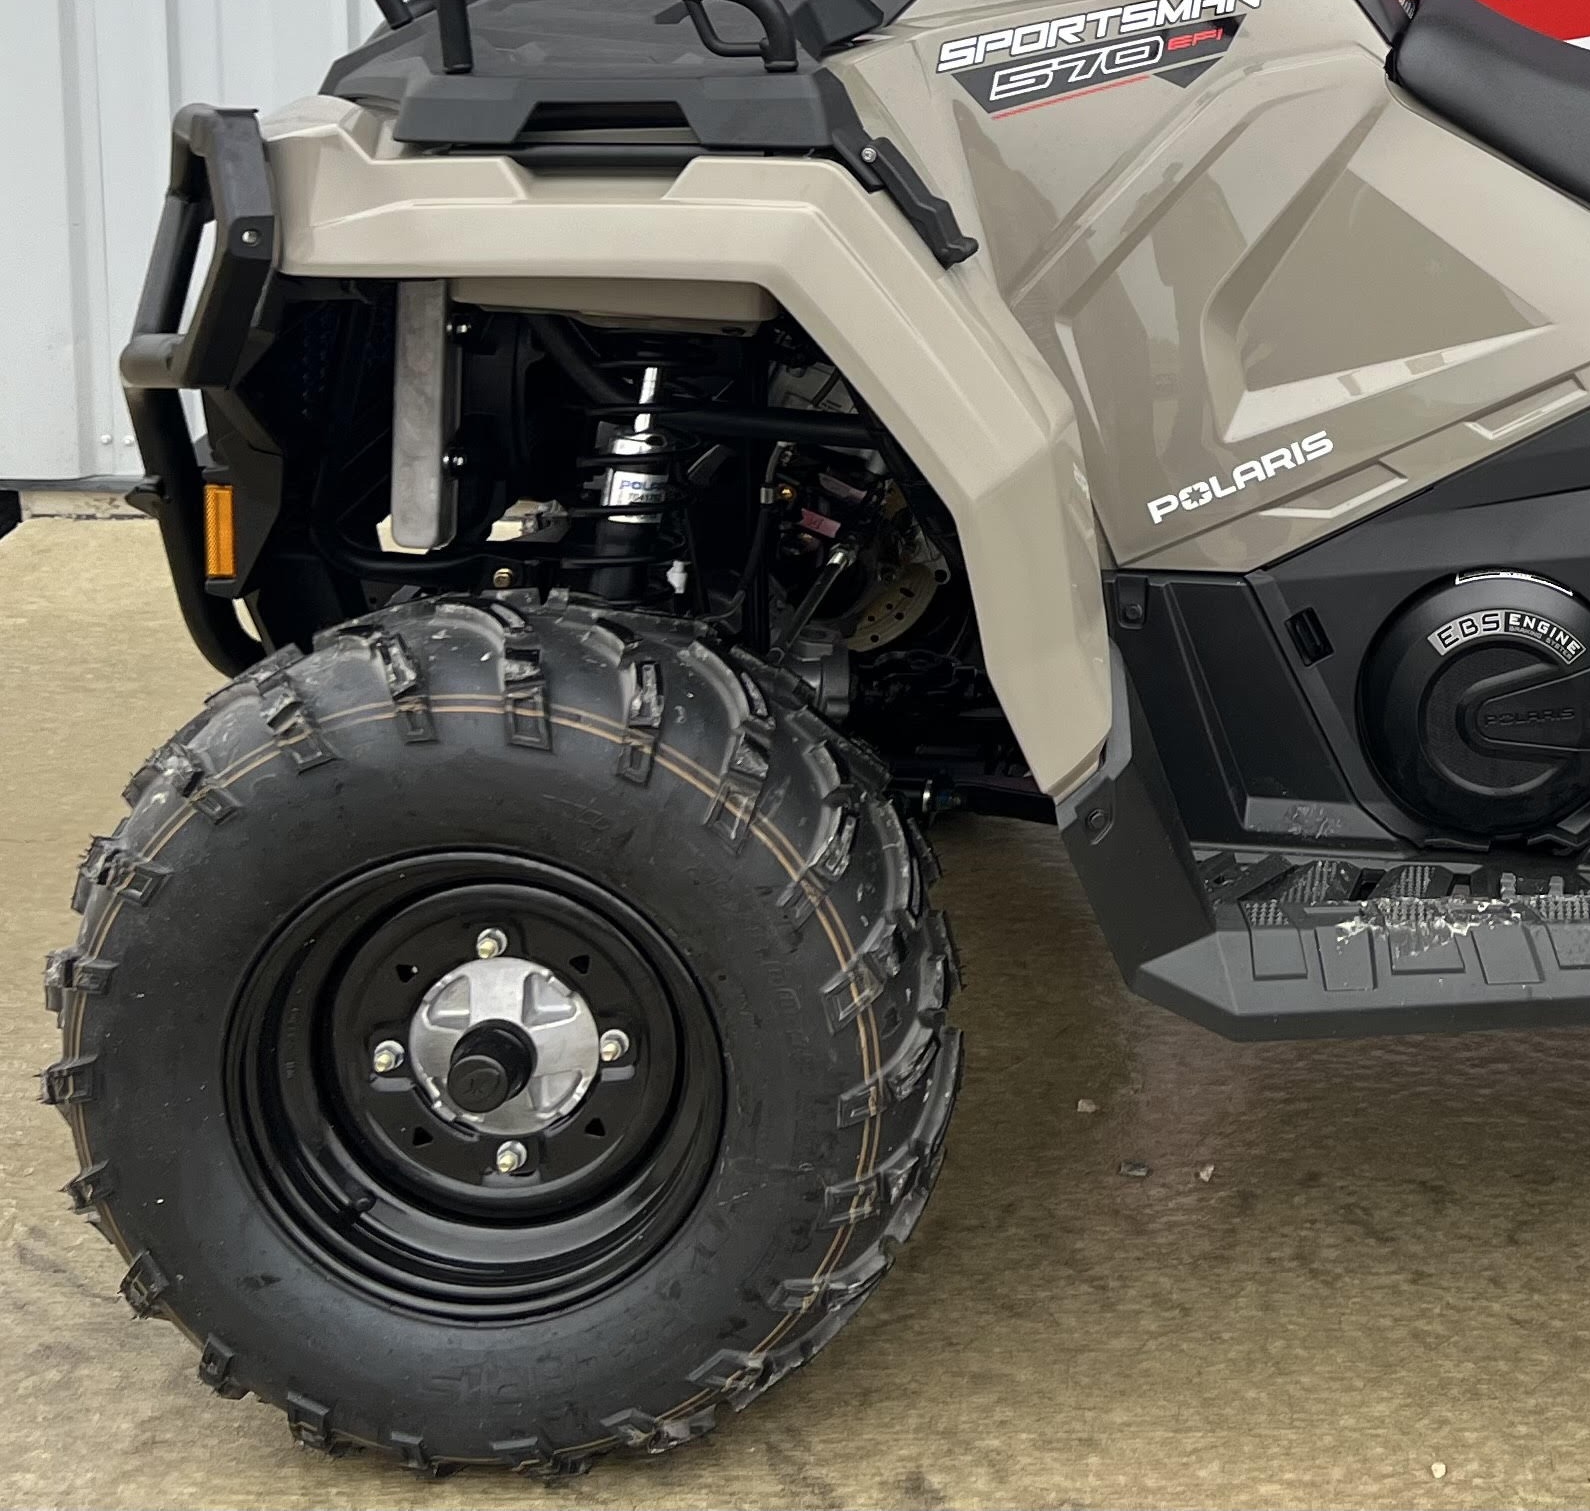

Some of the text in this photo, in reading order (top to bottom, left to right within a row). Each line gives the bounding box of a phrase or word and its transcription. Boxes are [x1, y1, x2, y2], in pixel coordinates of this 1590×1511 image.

[989, 28, 1223, 101] 570 EFI
[1146, 430, 1334, 524] POLARIS
[1437, 613, 1581, 655] EBS ENGINE
[1485, 707, 1576, 728] POLARIS
